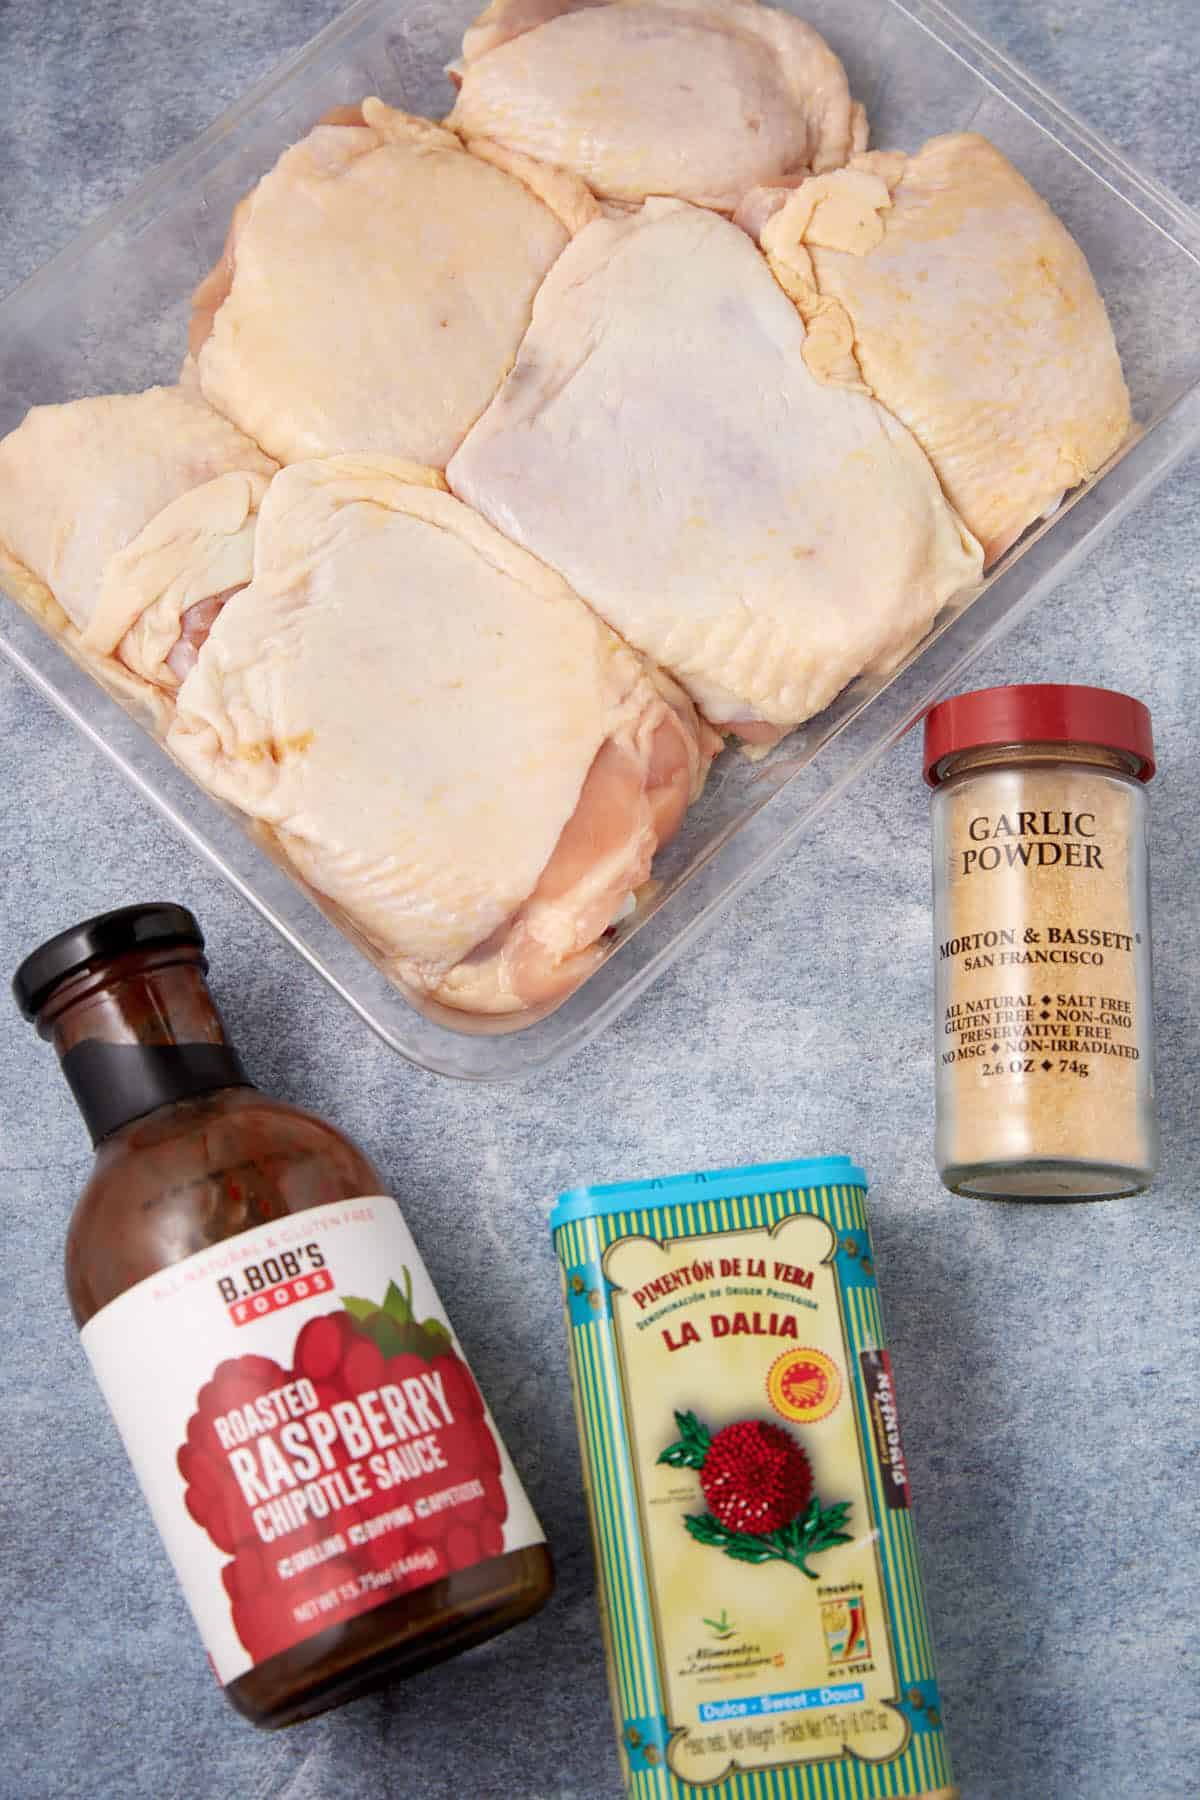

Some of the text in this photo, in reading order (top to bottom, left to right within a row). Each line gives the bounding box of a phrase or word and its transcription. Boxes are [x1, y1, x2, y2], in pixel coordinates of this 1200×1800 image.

[969, 811, 1095, 841] GARLIC
[961, 842, 1104, 875] POWDER
[940, 928, 1016, 960] MORTON
[1023, 927, 1041, 944] &
[964, 950, 1104, 971] SAN FRANCISCO
[945, 995, 1131, 1020] ALL NATURAL SALT FREE
[945, 1009, 1132, 1035] GLUTEN FREE NON-GMO
[960, 1024, 1112, 1045] PRESERVATIVE FREE
[942, 1039, 1140, 1066] NO MSG NON-IRRADIATED
[982, 1060, 1089, 1078] 2.6 OZ 74g
[217, 1243, 326, 1304] B.BOB'S
[632, 1258, 815, 1310] PIMENTÓN DE LA VERA
[235, 1274, 328, 1321] FOODS
[661, 1312, 799, 1352] LA DALIA
[213, 1377, 320, 1450] ROASTED
[227, 1370, 454, 1507] RASPBERRY
[252, 1435, 449, 1544] CHIPOTLE SAUCE
[703, 1687, 861, 1720] Dulce Sweet Doux
